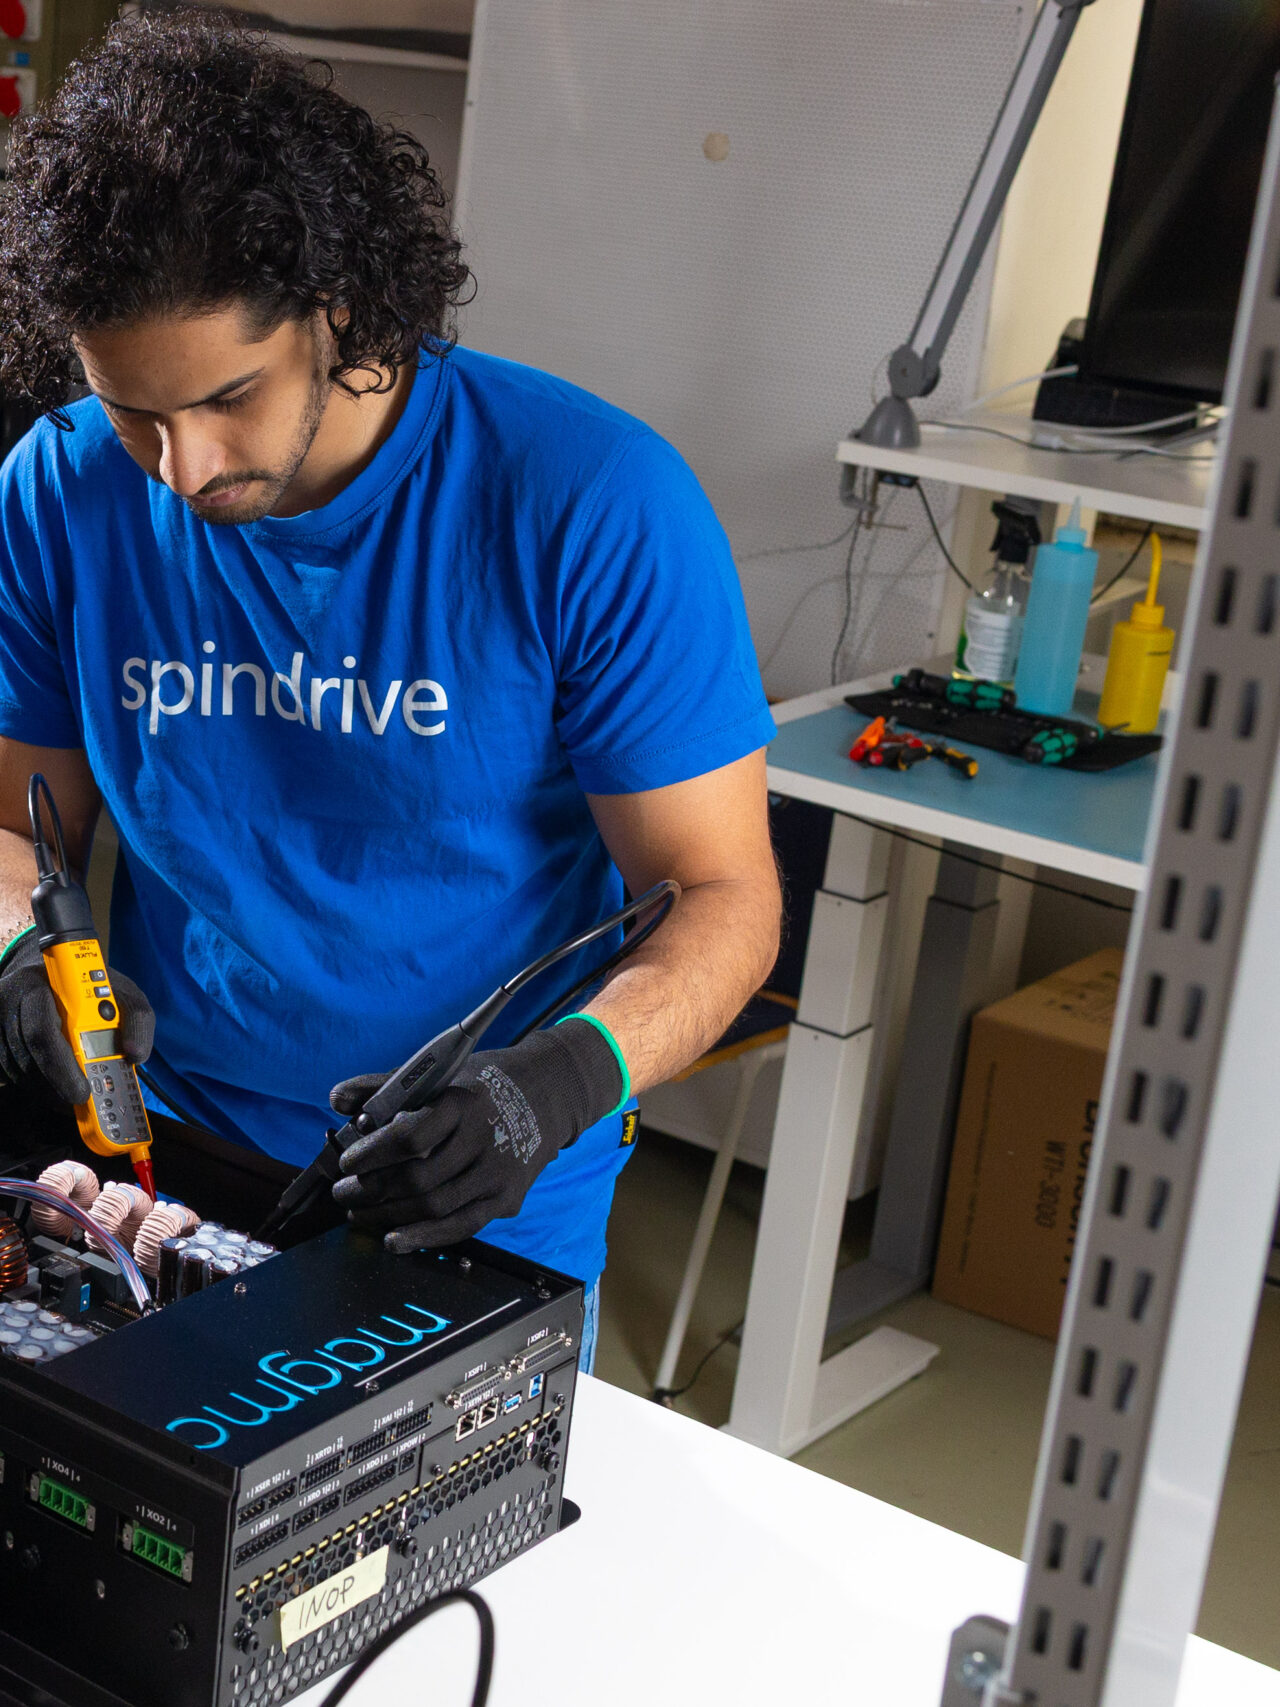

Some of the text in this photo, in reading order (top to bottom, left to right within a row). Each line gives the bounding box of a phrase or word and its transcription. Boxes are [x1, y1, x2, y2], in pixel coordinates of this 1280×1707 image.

[121, 640, 449, 737] spindrive
[165, 1302, 454, 1449] magmc
[51, 1459, 70, 1476] XO4
[146, 1508, 166, 1525] XO2
[297, 1574, 356, 1630] INOP
